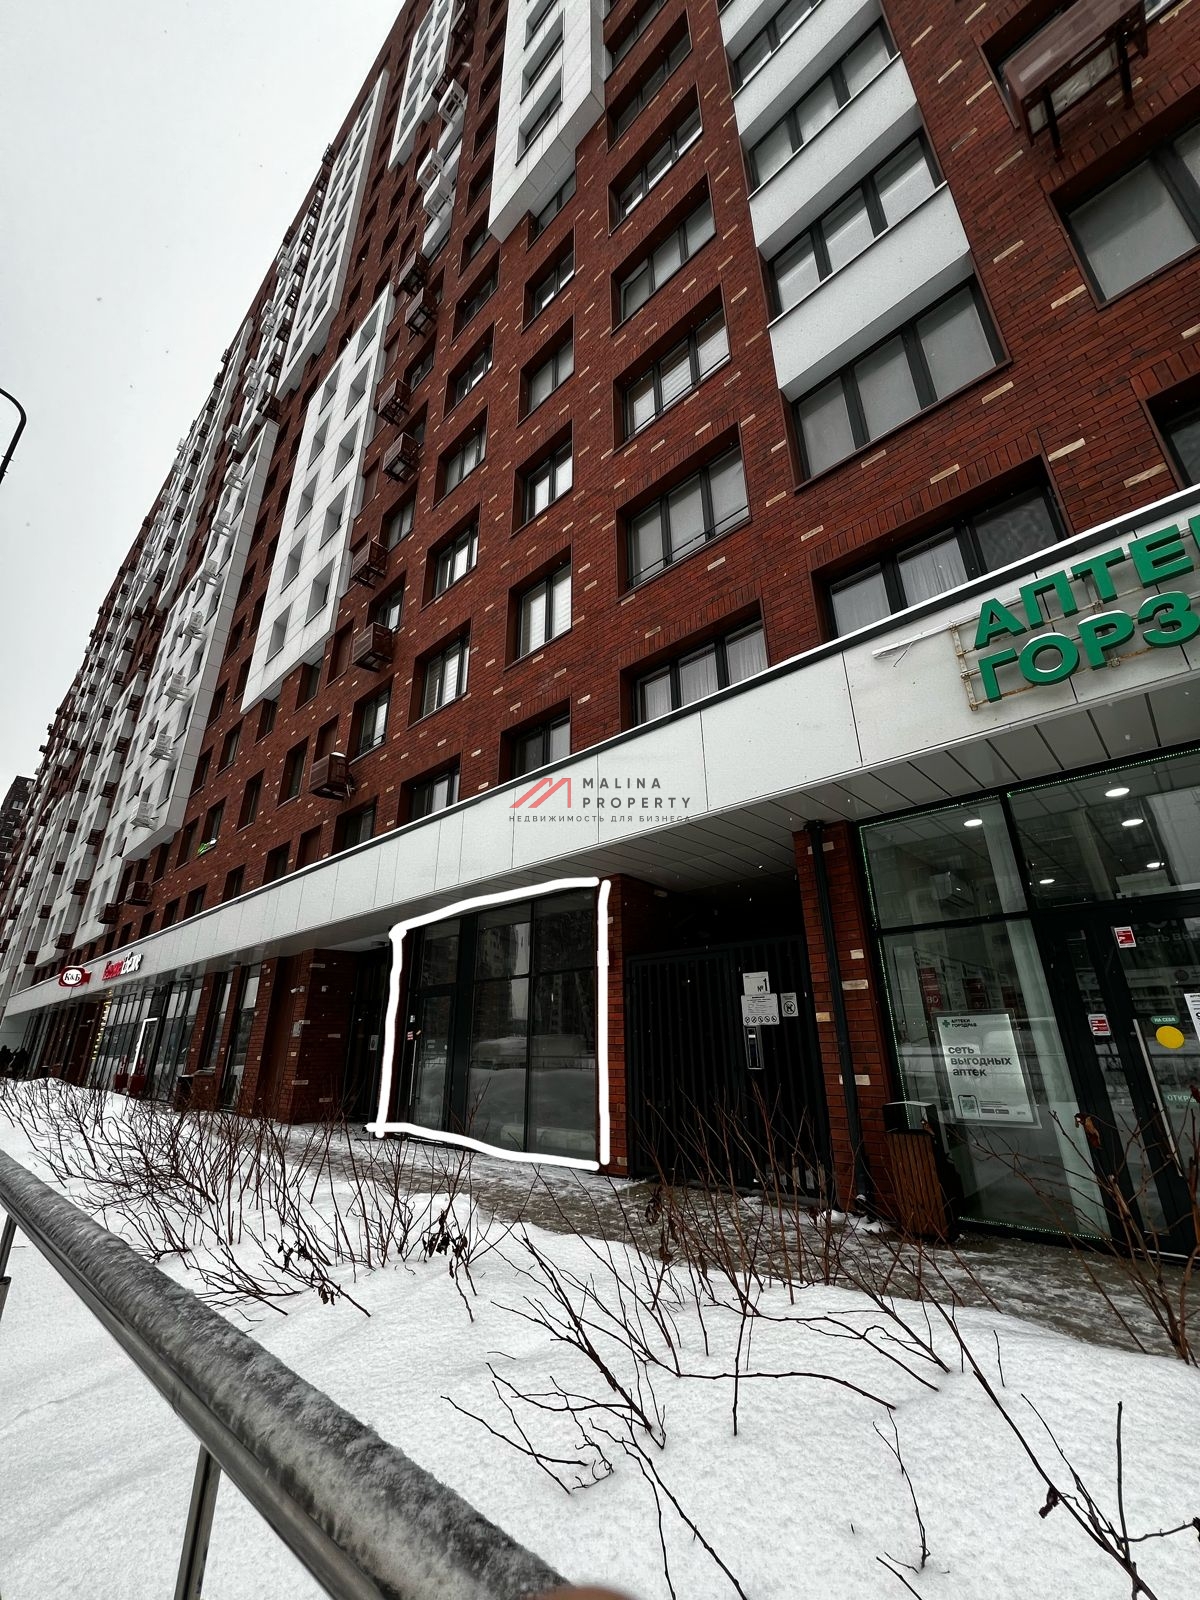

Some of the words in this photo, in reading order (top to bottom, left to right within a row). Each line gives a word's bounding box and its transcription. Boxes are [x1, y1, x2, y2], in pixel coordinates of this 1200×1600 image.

[978, 591, 1200, 703] ГОРЗ
[948, 1046, 975, 1054] сеть
[950, 1057, 1012, 1067] выгодных
[952, 1069, 987, 1077] аптек
